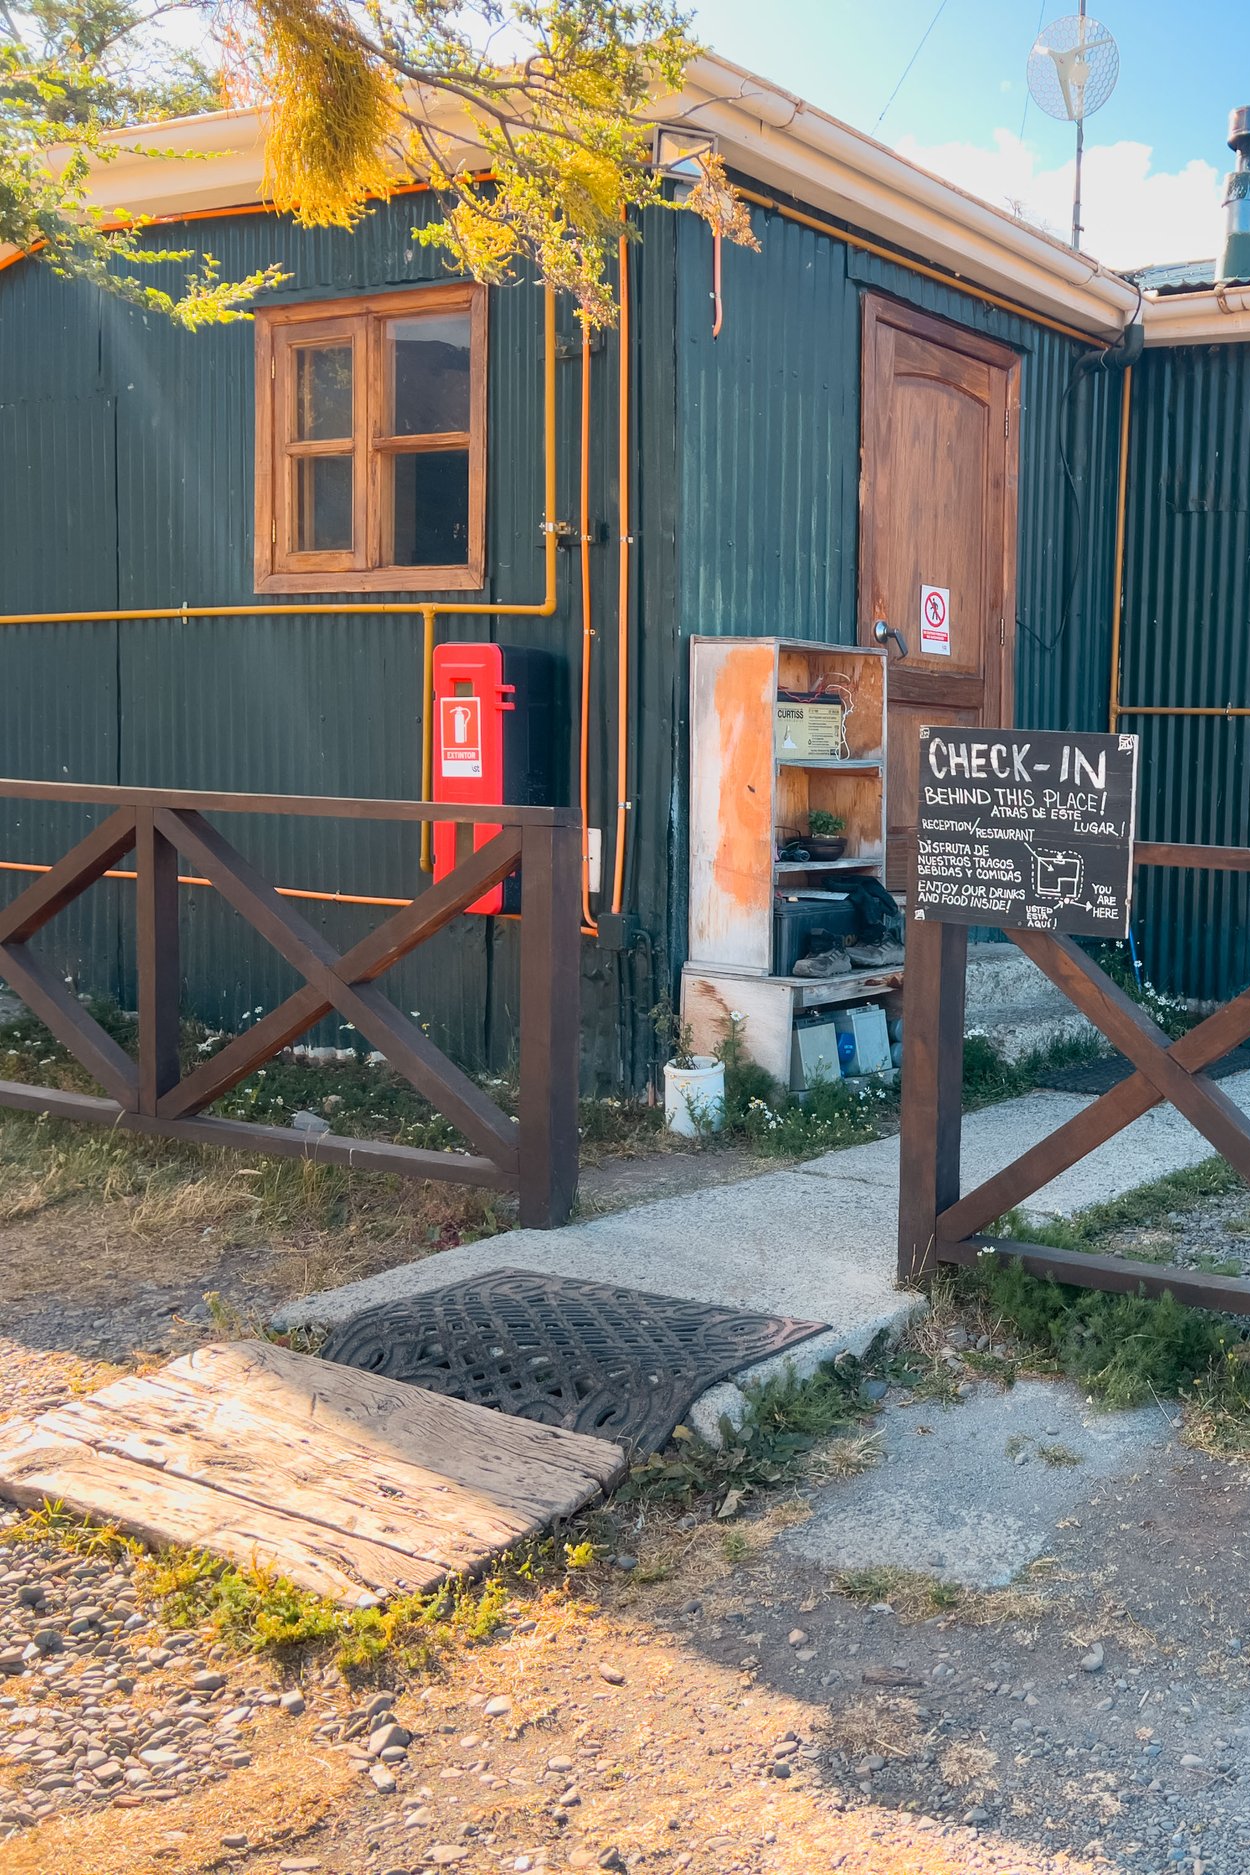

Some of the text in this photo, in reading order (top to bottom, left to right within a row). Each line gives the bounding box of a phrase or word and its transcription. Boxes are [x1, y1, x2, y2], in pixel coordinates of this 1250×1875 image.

[777, 709, 804, 719] CURTISS
[447, 751, 476, 759] EXTINTOR
[928, 737, 1106, 789] CHECK-IN
[924, 787, 1107, 815] BEHIND THIS PLACE!
[990, 805, 1082, 820] ATRAS DE ESTE
[973, 844, 989, 856] DE
[917, 854, 1014, 869] NUESTROS TRAGOS
[917, 865, 1022, 882] BEBIDAS Y COMIDAS
[918, 880, 1026, 900] ENJOY OUR DRINKS
[1092, 883, 1112, 894] YOU
[918, 892, 1011, 913] AND FOOD INSIDE!
[1096, 896, 1116, 906] ARE
[1025, 905, 1053, 914] USTED
[1092, 907, 1119, 919] HERE
